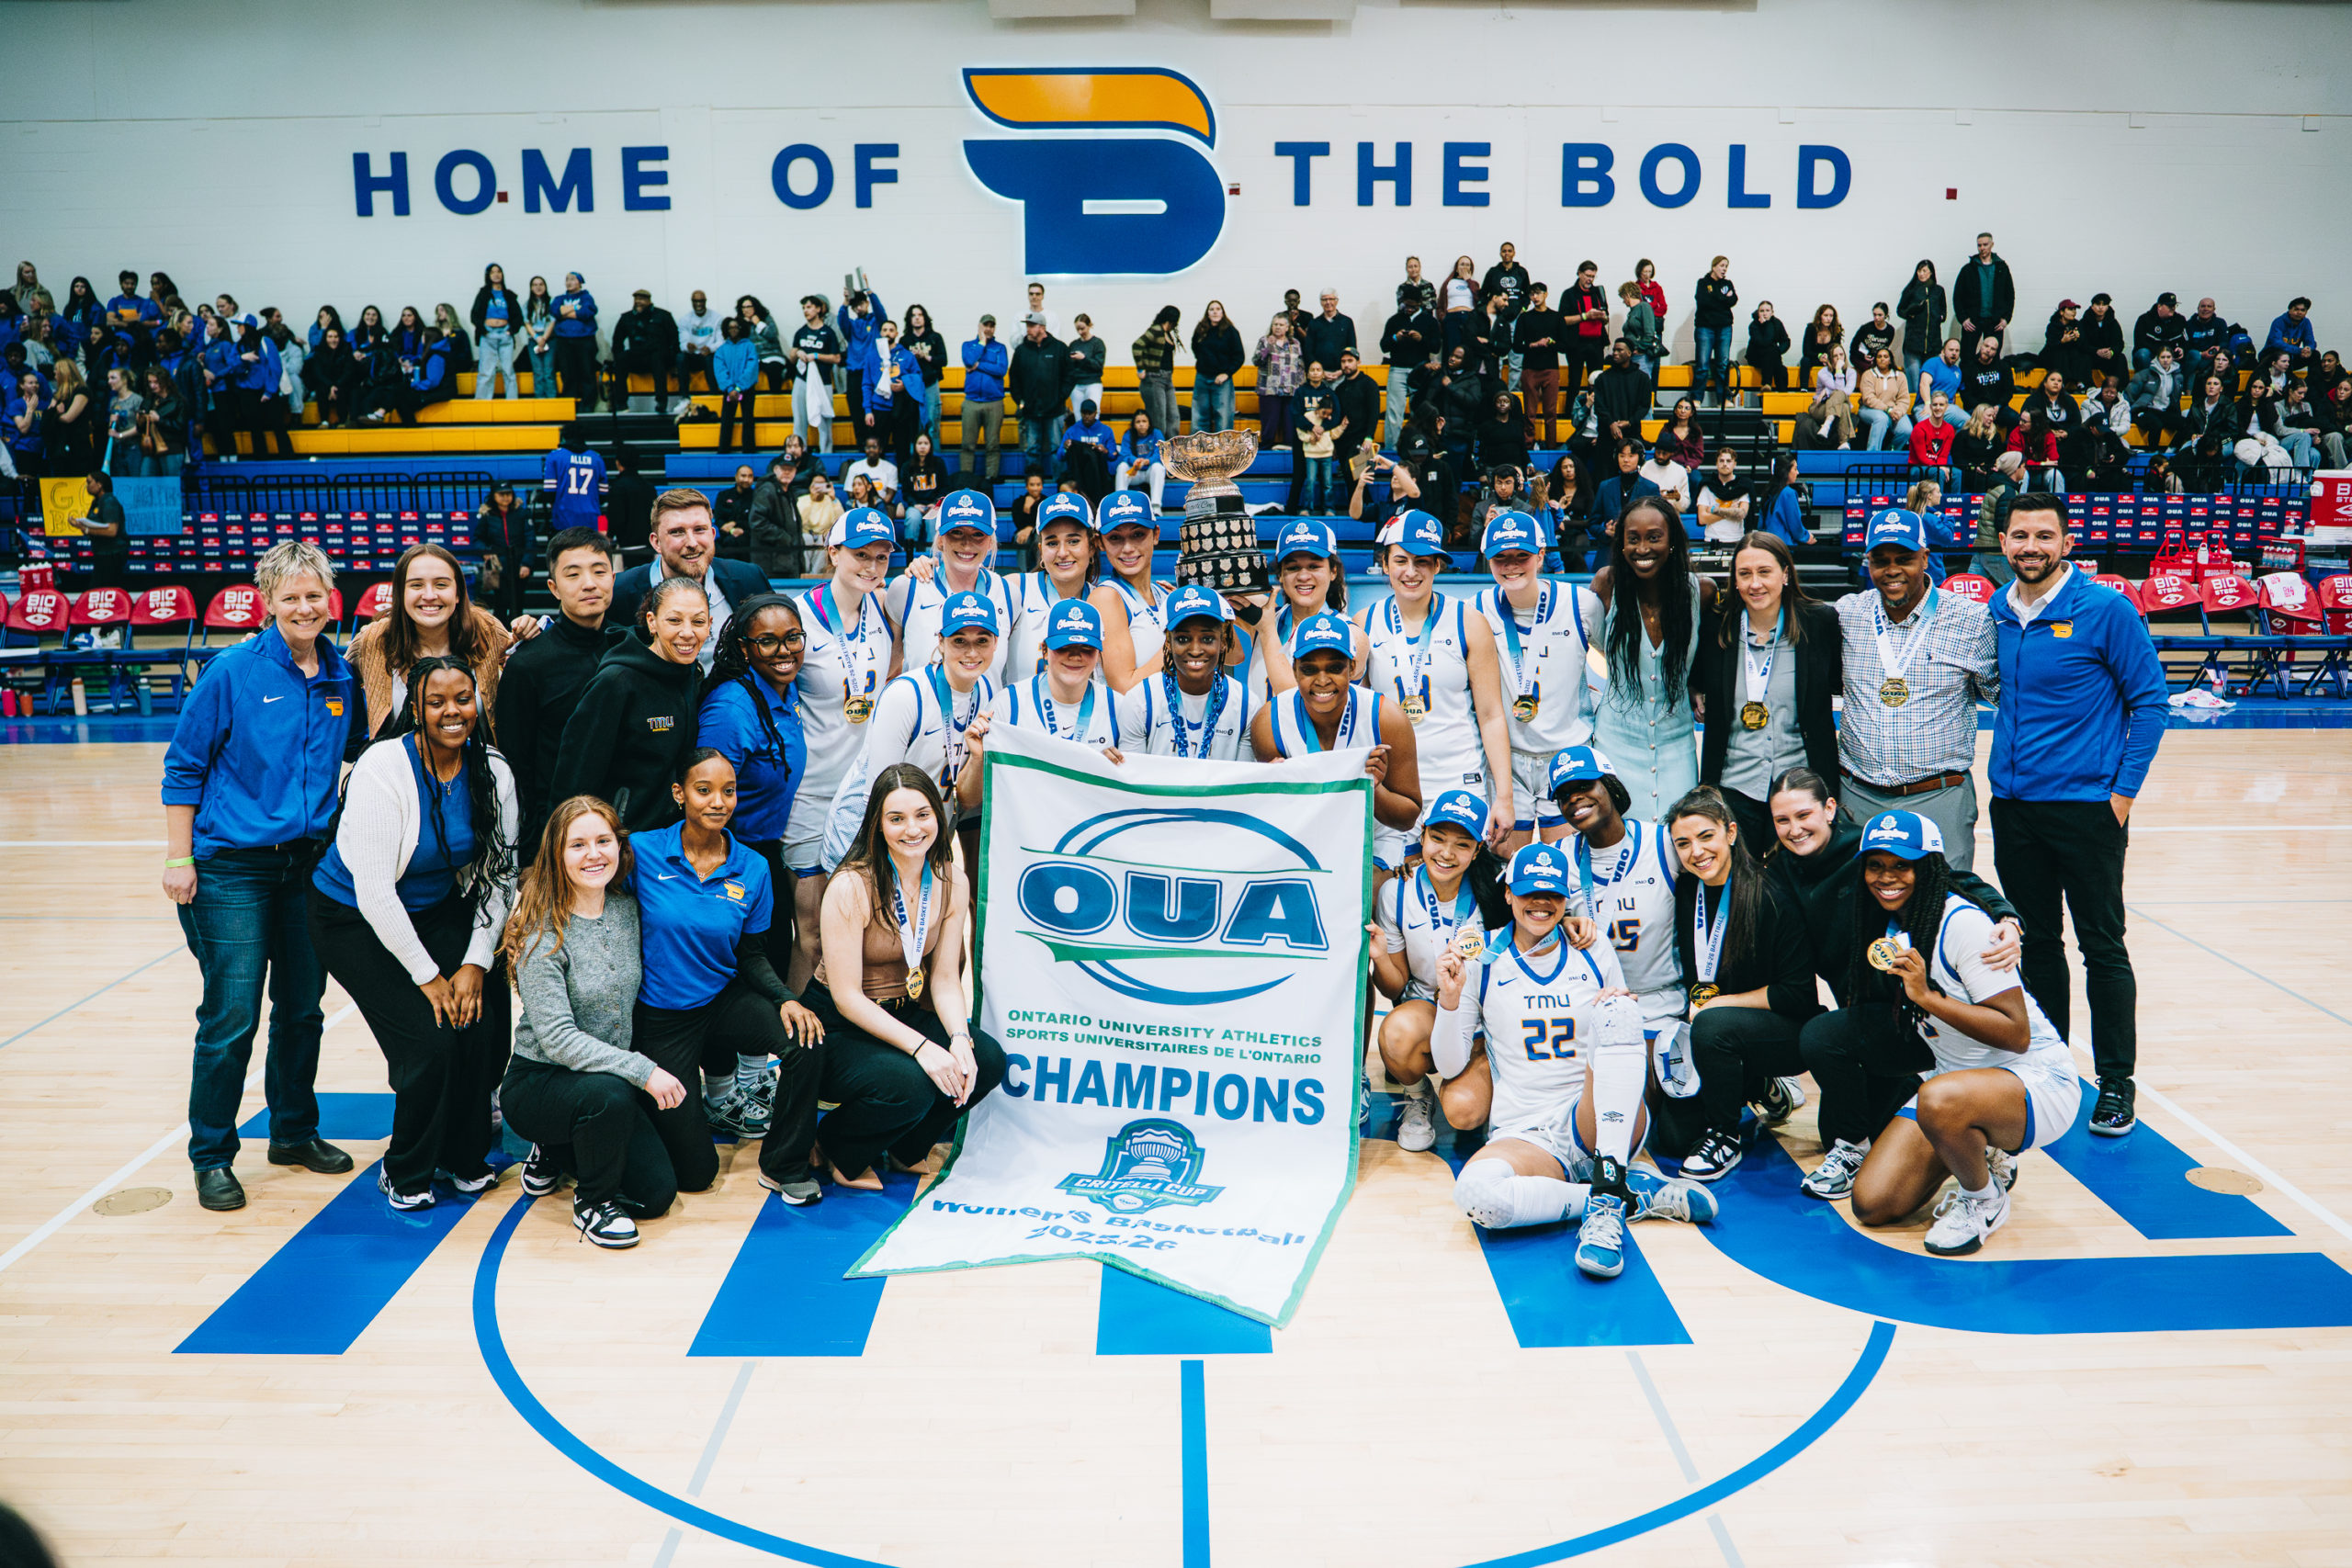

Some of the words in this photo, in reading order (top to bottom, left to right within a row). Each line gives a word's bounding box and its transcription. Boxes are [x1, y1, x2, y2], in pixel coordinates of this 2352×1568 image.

[352, 145, 672, 218] HOME
[771, 142, 900, 210] OF
[1273, 141, 1492, 208] THE
[1560, 141, 1853, 209] BOLD
[570, 455, 593, 465] ALLEN
[568, 467, 594, 495] 17
[88, 590, 116, 603] BIO
[149, 589, 177, 602] BIO
[224, 591, 254, 604] BIO
[376, 584, 393, 596] BI
[1952, 580, 1982, 592] BIO
[2154, 575, 2181, 589] BIO
[2211, 576, 2238, 590] BIO
[27, 594, 57, 607] BIO
[1535, 591, 1547, 625] OUA
[1392, 604, 1403, 635] OUA
[1874, 604, 1884, 637] OUA
[837, 632, 854, 669] BASKETBALL
[646, 716, 674, 729] TMU
[1043, 699, 1058, 735] OUA
[1612, 847, 1630, 883] OUA
[894, 889, 909, 927] OUA
[920, 886, 930, 927] BASKETBALL
[1017, 860, 1330, 951] OUA
[1427, 893, 1441, 931] OUA
[916, 927, 925, 953] 2025-26
[1709, 914, 1726, 953] BASKETBALL
[1704, 952, 1715, 977] 2025-26
[909, 979, 923, 990] OUA
[1523, 993, 1572, 1010] TMU
[1007, 1010, 1092, 1027] ONTARIO
[1098, 1018, 1216, 1039] UNIVERSITY
[1221, 1029, 1323, 1048] ATHLETICS
[1521, 1016, 1577, 1061] 22
[1006, 1028, 1069, 1043] SPORTS
[1074, 1032, 1209, 1055] UNIVERSITAIRES
[1214, 1046, 1235, 1057] DE
[1238, 1049, 1322, 1064] L'ONTARIO
[1001, 1053, 1325, 1126] CHAMPIONS
[1073, 1178, 1163, 1191] CRITELLI
[1163, 1183, 1209, 1197] CUP
